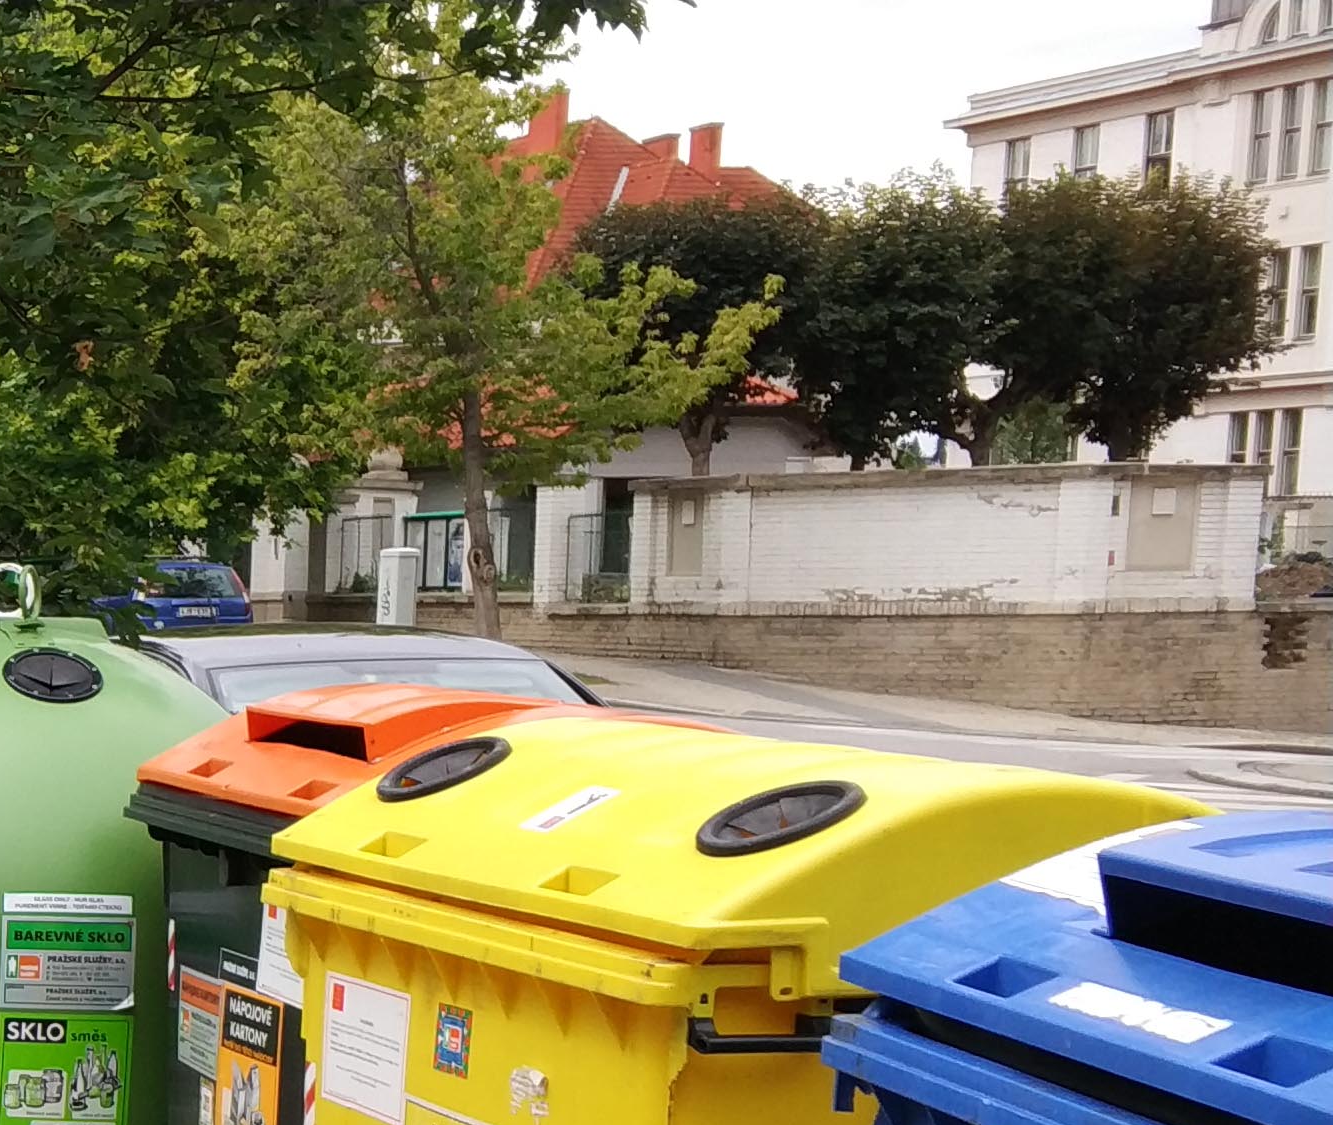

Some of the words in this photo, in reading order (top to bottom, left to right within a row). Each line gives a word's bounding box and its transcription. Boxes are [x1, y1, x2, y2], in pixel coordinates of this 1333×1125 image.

[14, 929, 84, 943] BAREVNÉ
[87, 931, 125, 943] SKLO
[48, 954, 82, 963] PRAŽSKÉ
[229, 996, 273, 1026] NÁPOJOVÉ
[6, 1021, 65, 1042] SKLO
[70, 1029, 107, 1042] směs
[229, 1021, 268, 1048] KARTONY
